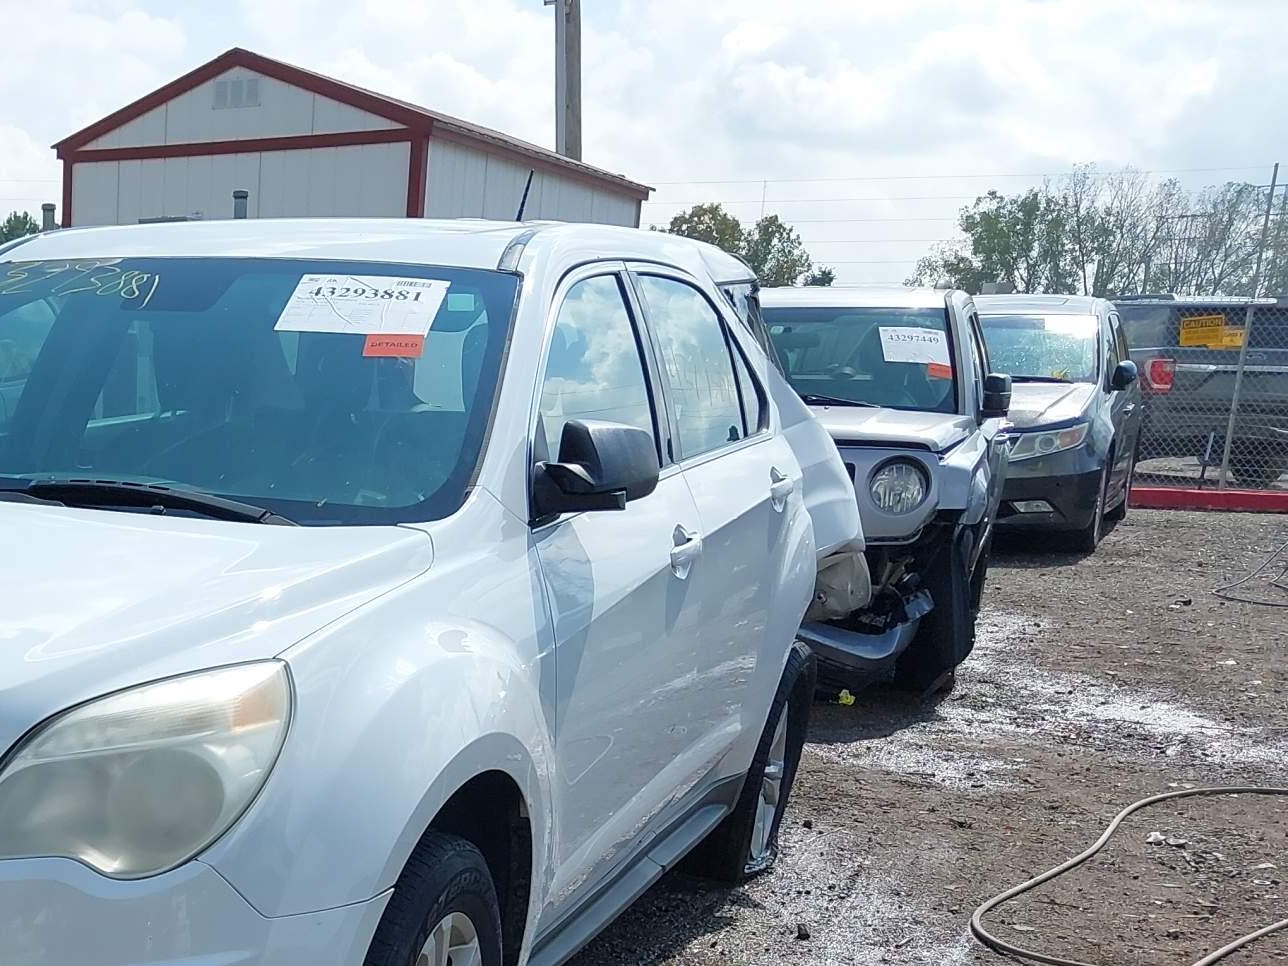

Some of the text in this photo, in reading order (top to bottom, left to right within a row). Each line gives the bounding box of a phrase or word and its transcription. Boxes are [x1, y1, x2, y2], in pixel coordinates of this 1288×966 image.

[308, 285, 423, 303] 43293881
[1183, 317, 1223, 330] CAUTION
[887, 333, 940, 345] 43297449
[370, 341, 419, 350] DETAILED
